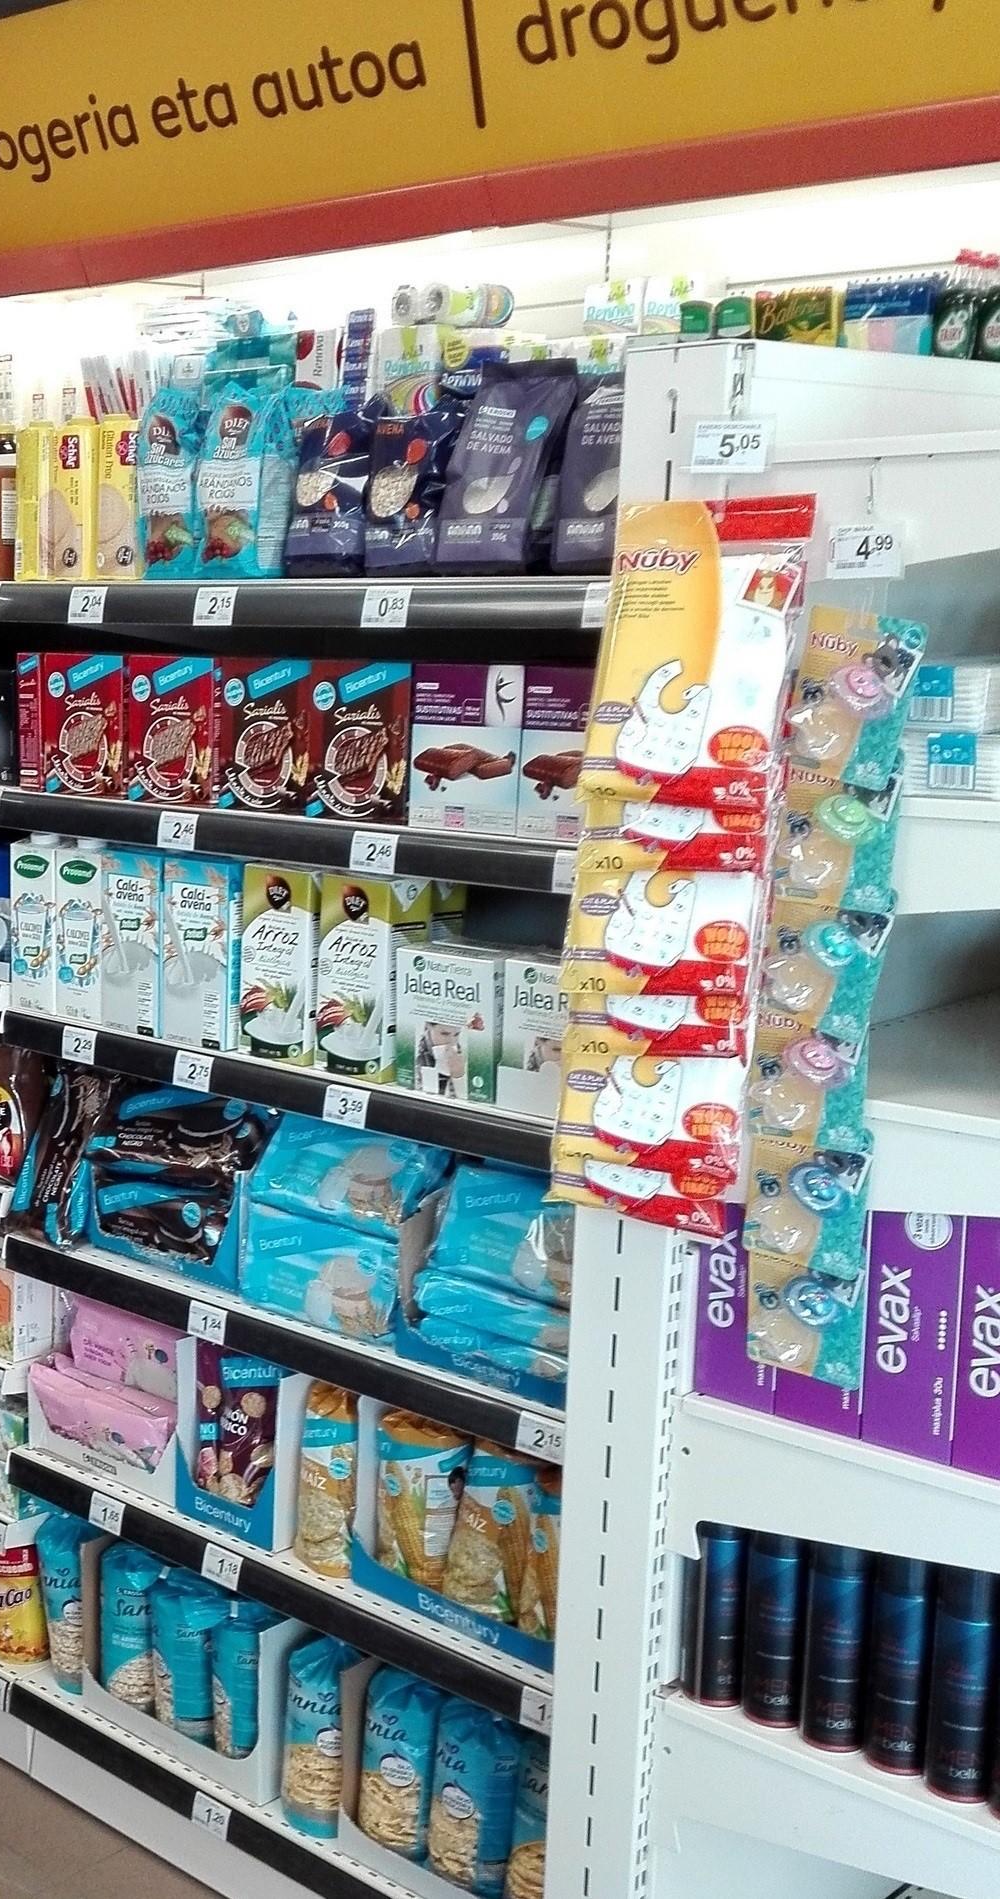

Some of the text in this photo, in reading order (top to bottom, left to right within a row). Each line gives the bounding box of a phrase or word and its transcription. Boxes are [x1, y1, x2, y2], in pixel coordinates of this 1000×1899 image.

[149, 76, 238, 139] eta
[252, 34, 426, 119] autoa
[313, 334, 324, 377] Renova
[224, 418, 250, 430] DIET
[466, 442, 512, 454] DE AVENA
[470, 431, 514, 444] SALVADO
[158, 663, 194, 686] Bicentury
[253, 666, 292, 690] Bicentury
[345, 668, 387, 693] Bicentury
[595, 855, 623, 871] x10
[116, 890, 144, 903] avena
[180, 899, 212, 912] avena
[404, 975, 480, 1004] Jalea Real
[580, 977, 605, 992] x10
[513, 989, 553, 1011] Jalea
[581, 1041, 609, 1054] x10
[259, 1234, 302, 1251] Bicentury
[706, 1229, 738, 1328] evax
[875, 1264, 912, 1374] evax
[194, 1496, 251, 1533] Bicentury
[417, 1593, 500, 1644] Bicentury
